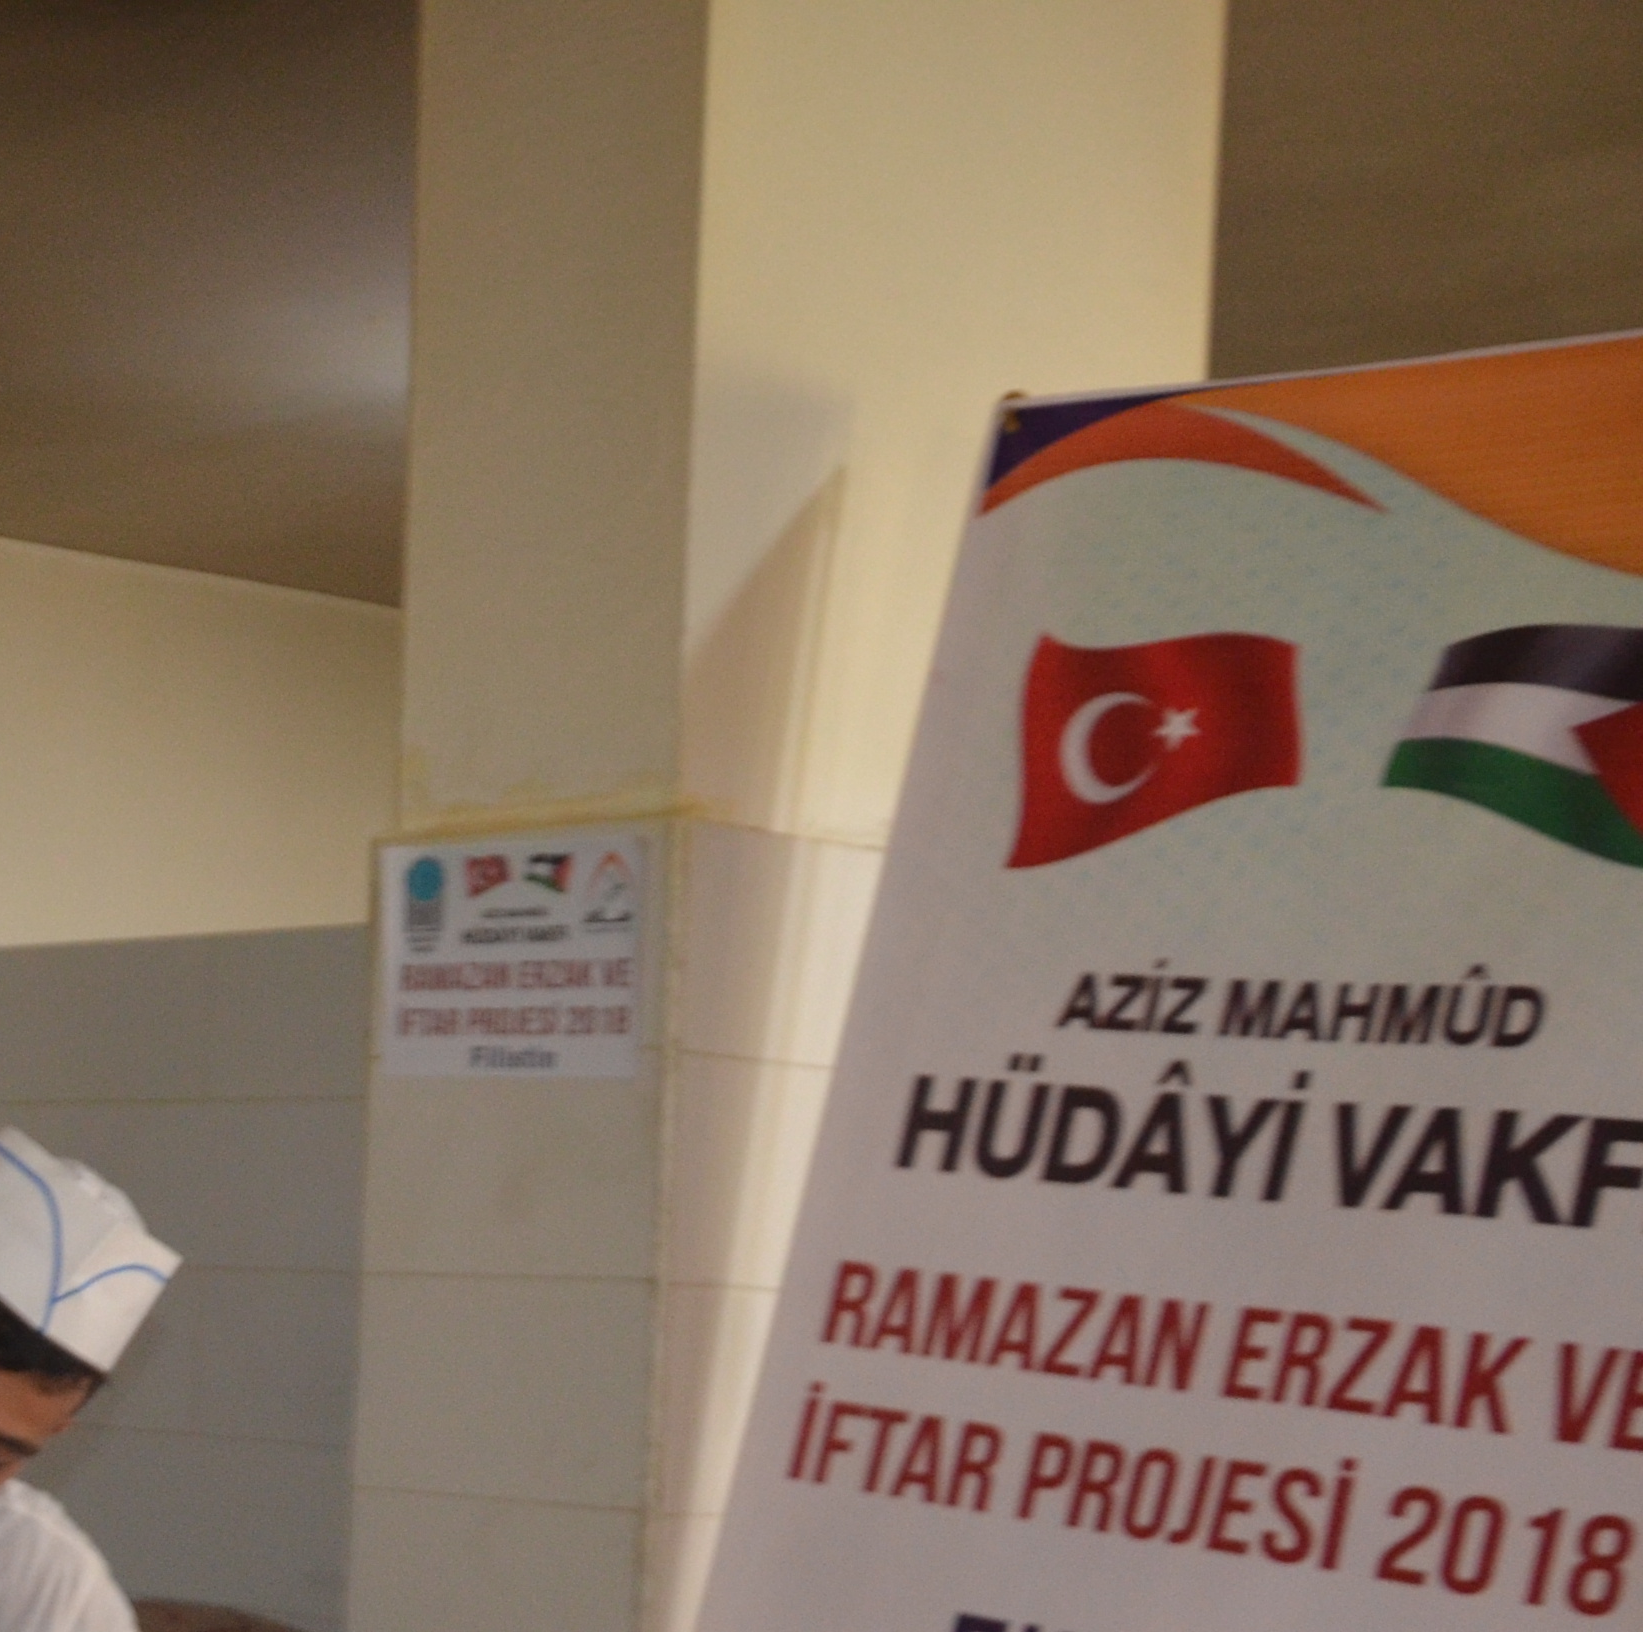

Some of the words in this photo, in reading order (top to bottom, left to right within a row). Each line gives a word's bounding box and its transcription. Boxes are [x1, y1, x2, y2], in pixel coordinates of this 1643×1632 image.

[1055, 960, 1210, 1037] AZİZ
[1217, 964, 1547, 1049] MAHMÛD
[894, 1053, 1314, 1202] HÜDÂYİ
[820, 1258, 1210, 1391] RAMAZAN
[1219, 1305, 1533, 1436] ERZAK
[785, 1380, 1004, 1512] İFTAR
[1016, 1432, 1360, 1571] PROJESİ
[1375, 1485, 1635, 1617] 2018
